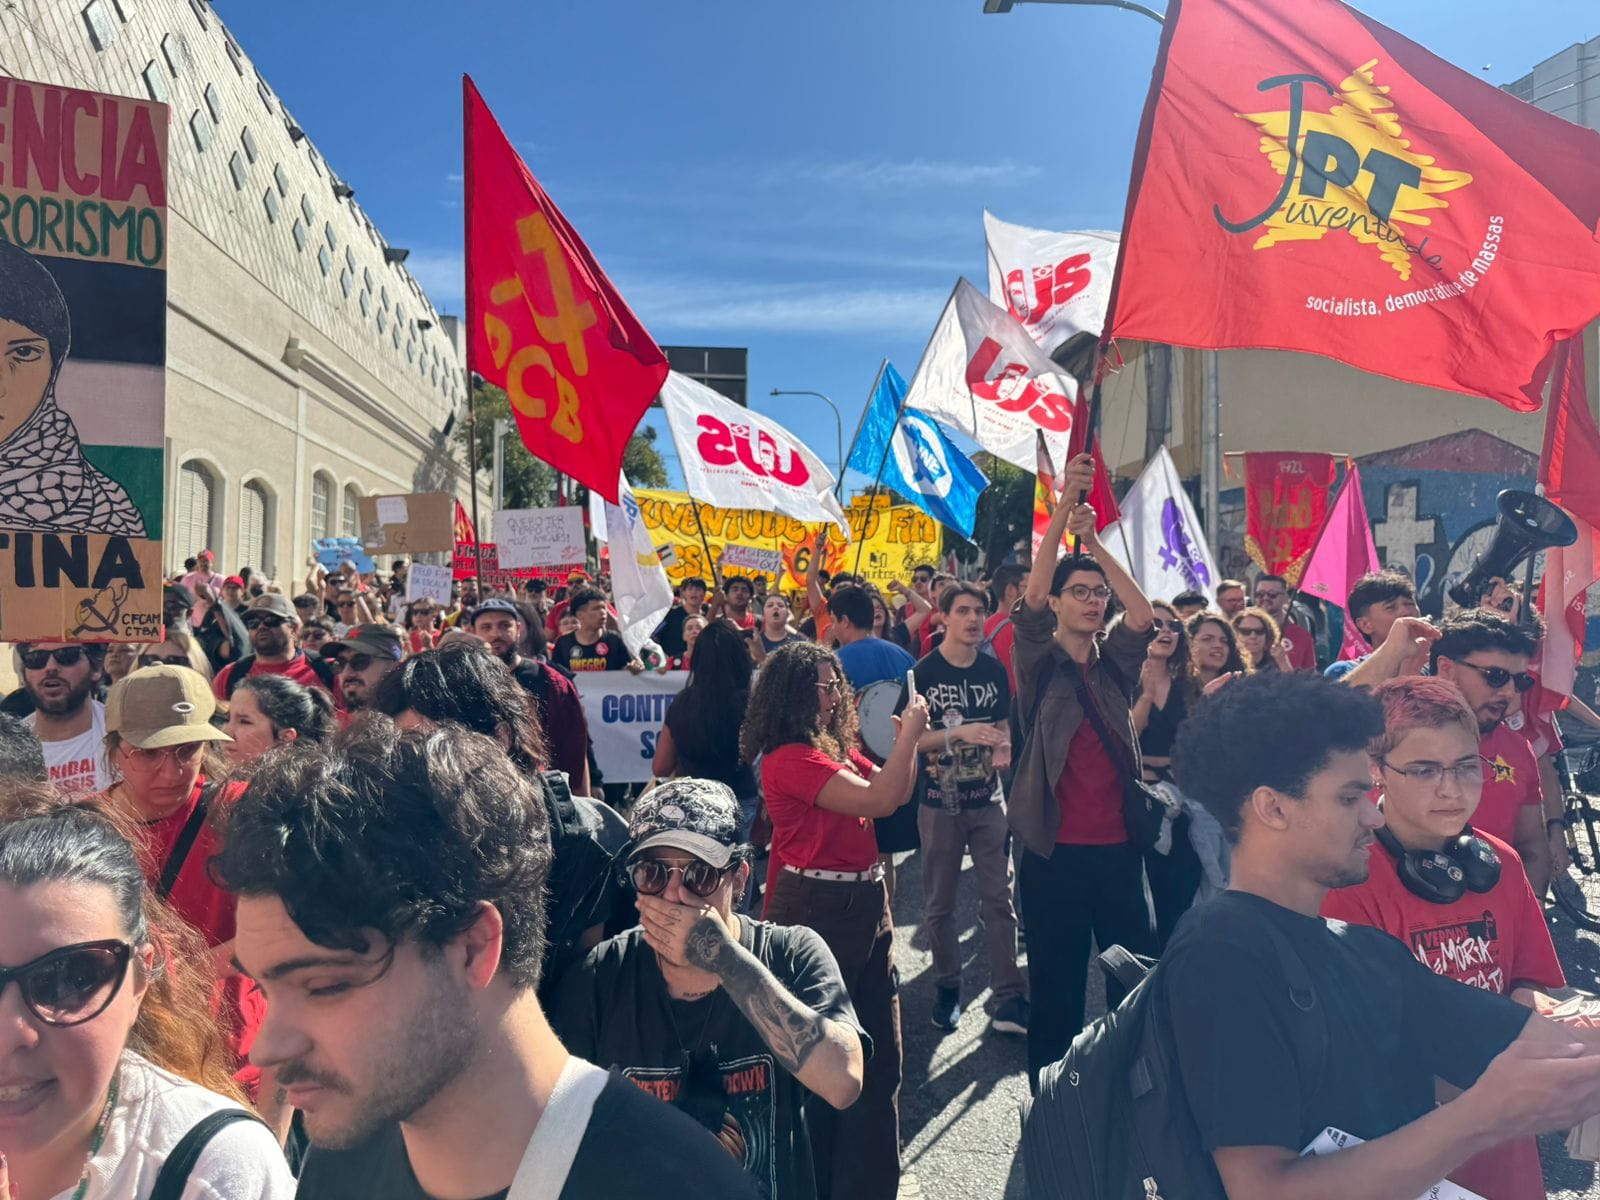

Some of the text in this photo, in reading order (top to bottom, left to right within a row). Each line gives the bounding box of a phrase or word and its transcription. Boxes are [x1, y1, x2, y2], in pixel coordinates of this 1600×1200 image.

[1305, 294, 1382, 317] socialista,
[1458, 270, 1479, 288] de
[1471, 215, 1504, 275] massas
